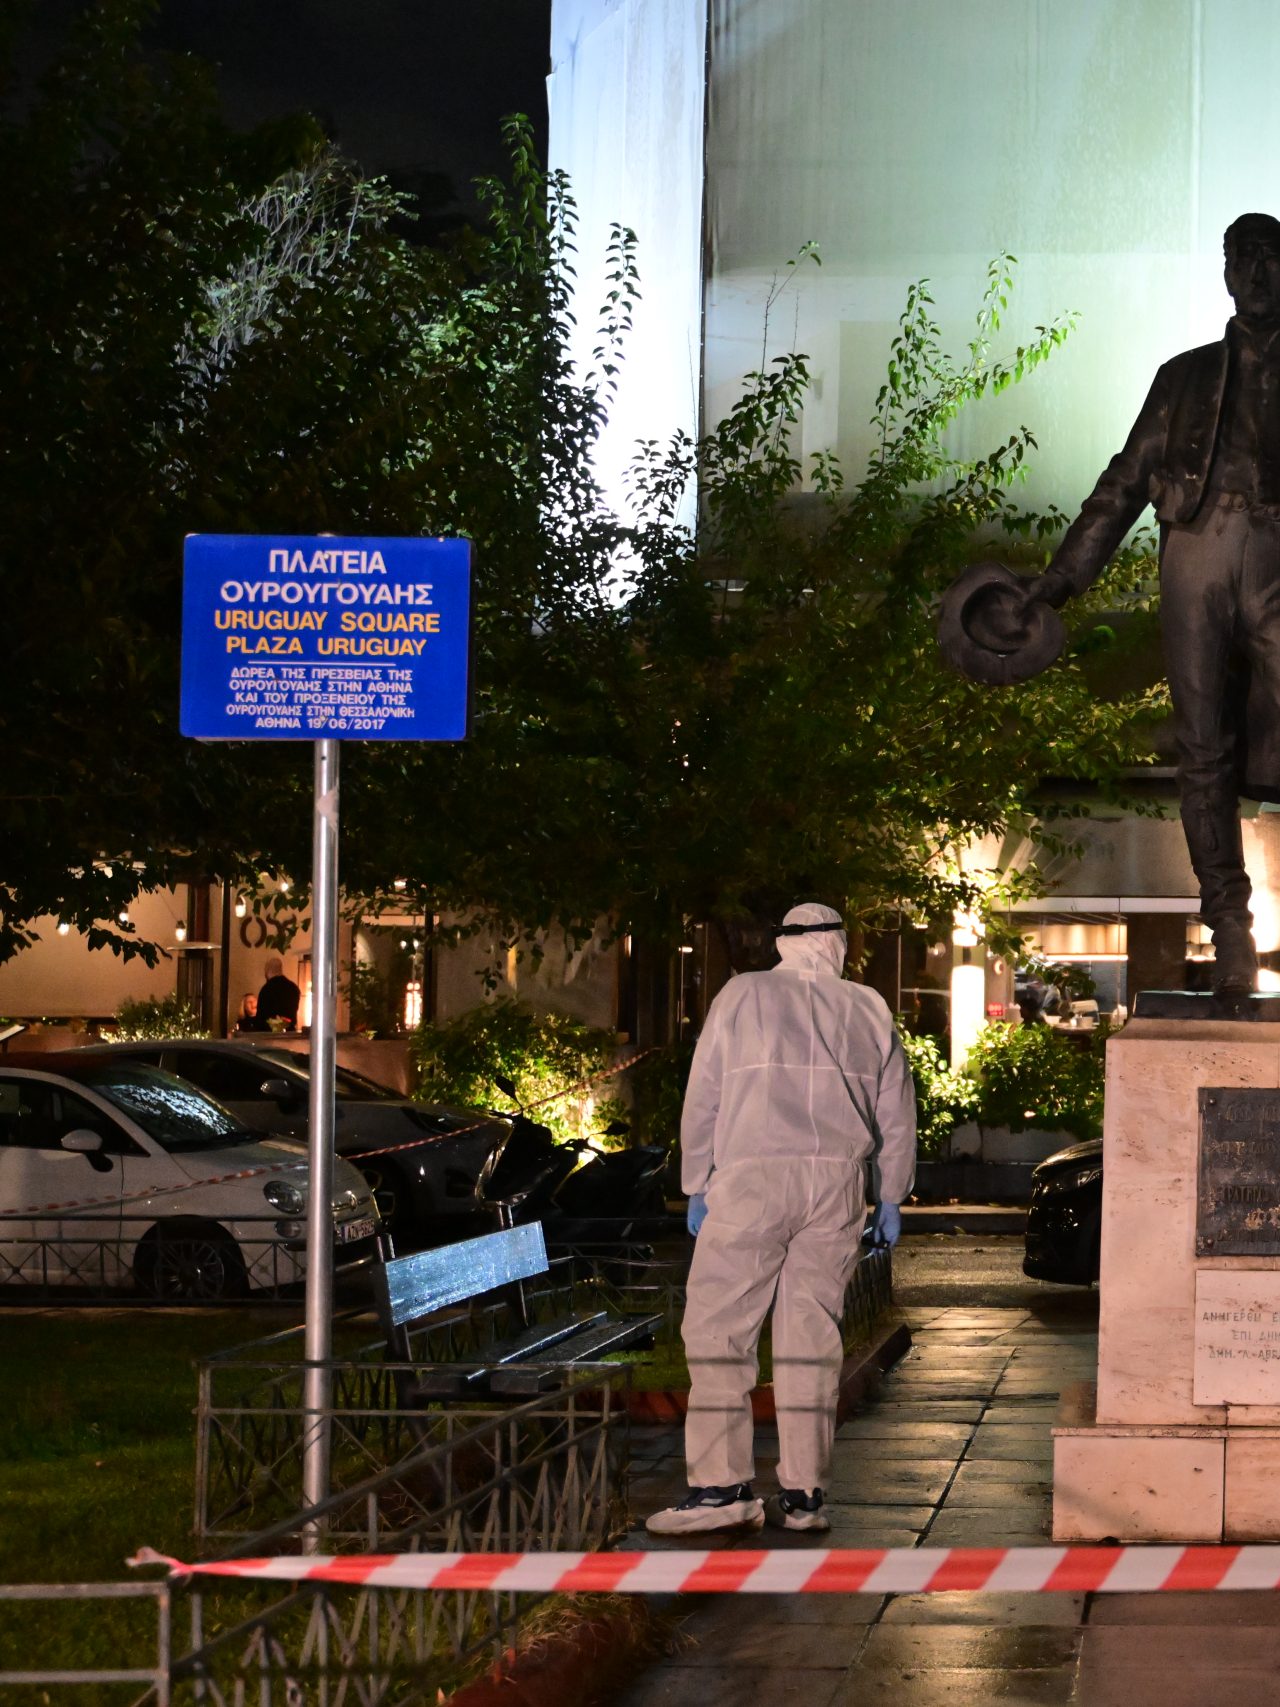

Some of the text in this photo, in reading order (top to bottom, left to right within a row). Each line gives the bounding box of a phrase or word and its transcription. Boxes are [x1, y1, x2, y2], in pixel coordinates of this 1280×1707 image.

[269, 550, 387, 574] ΠΛΑΤΕΙΑ
[220, 581, 433, 605] ΟΥΡΟΥΓΟΥΑΗΣ
[214, 610, 440, 633] URUGUAY SQUARE
[226, 636, 427, 656] PLAZA URUGUAY
[231, 667, 413, 681] ΔΩΡΕΑ ΤΗΣ ΠΡΕΣΒΕΙΑΣ ΤΗΣ
[229, 680, 413, 693] ΟΥΡΟΥΓΟΥΑΗΣ ΣΤΗΝ ΑΘΗΝΑ
[235, 692, 406, 705] ΚΑΙ ΤΟΥ ΠΡΟΞΕΝΕΙΟΥ ΤΗΣ
[226, 704, 415, 718] ΟΥΡΟΥΓΟΥΑΗΣ ΣΤΗΝ ΘΕΣΣΑΛΟΝΙΚΗ
[255, 717, 385, 730] ΑΘΗΝΑ 19/06/2017
